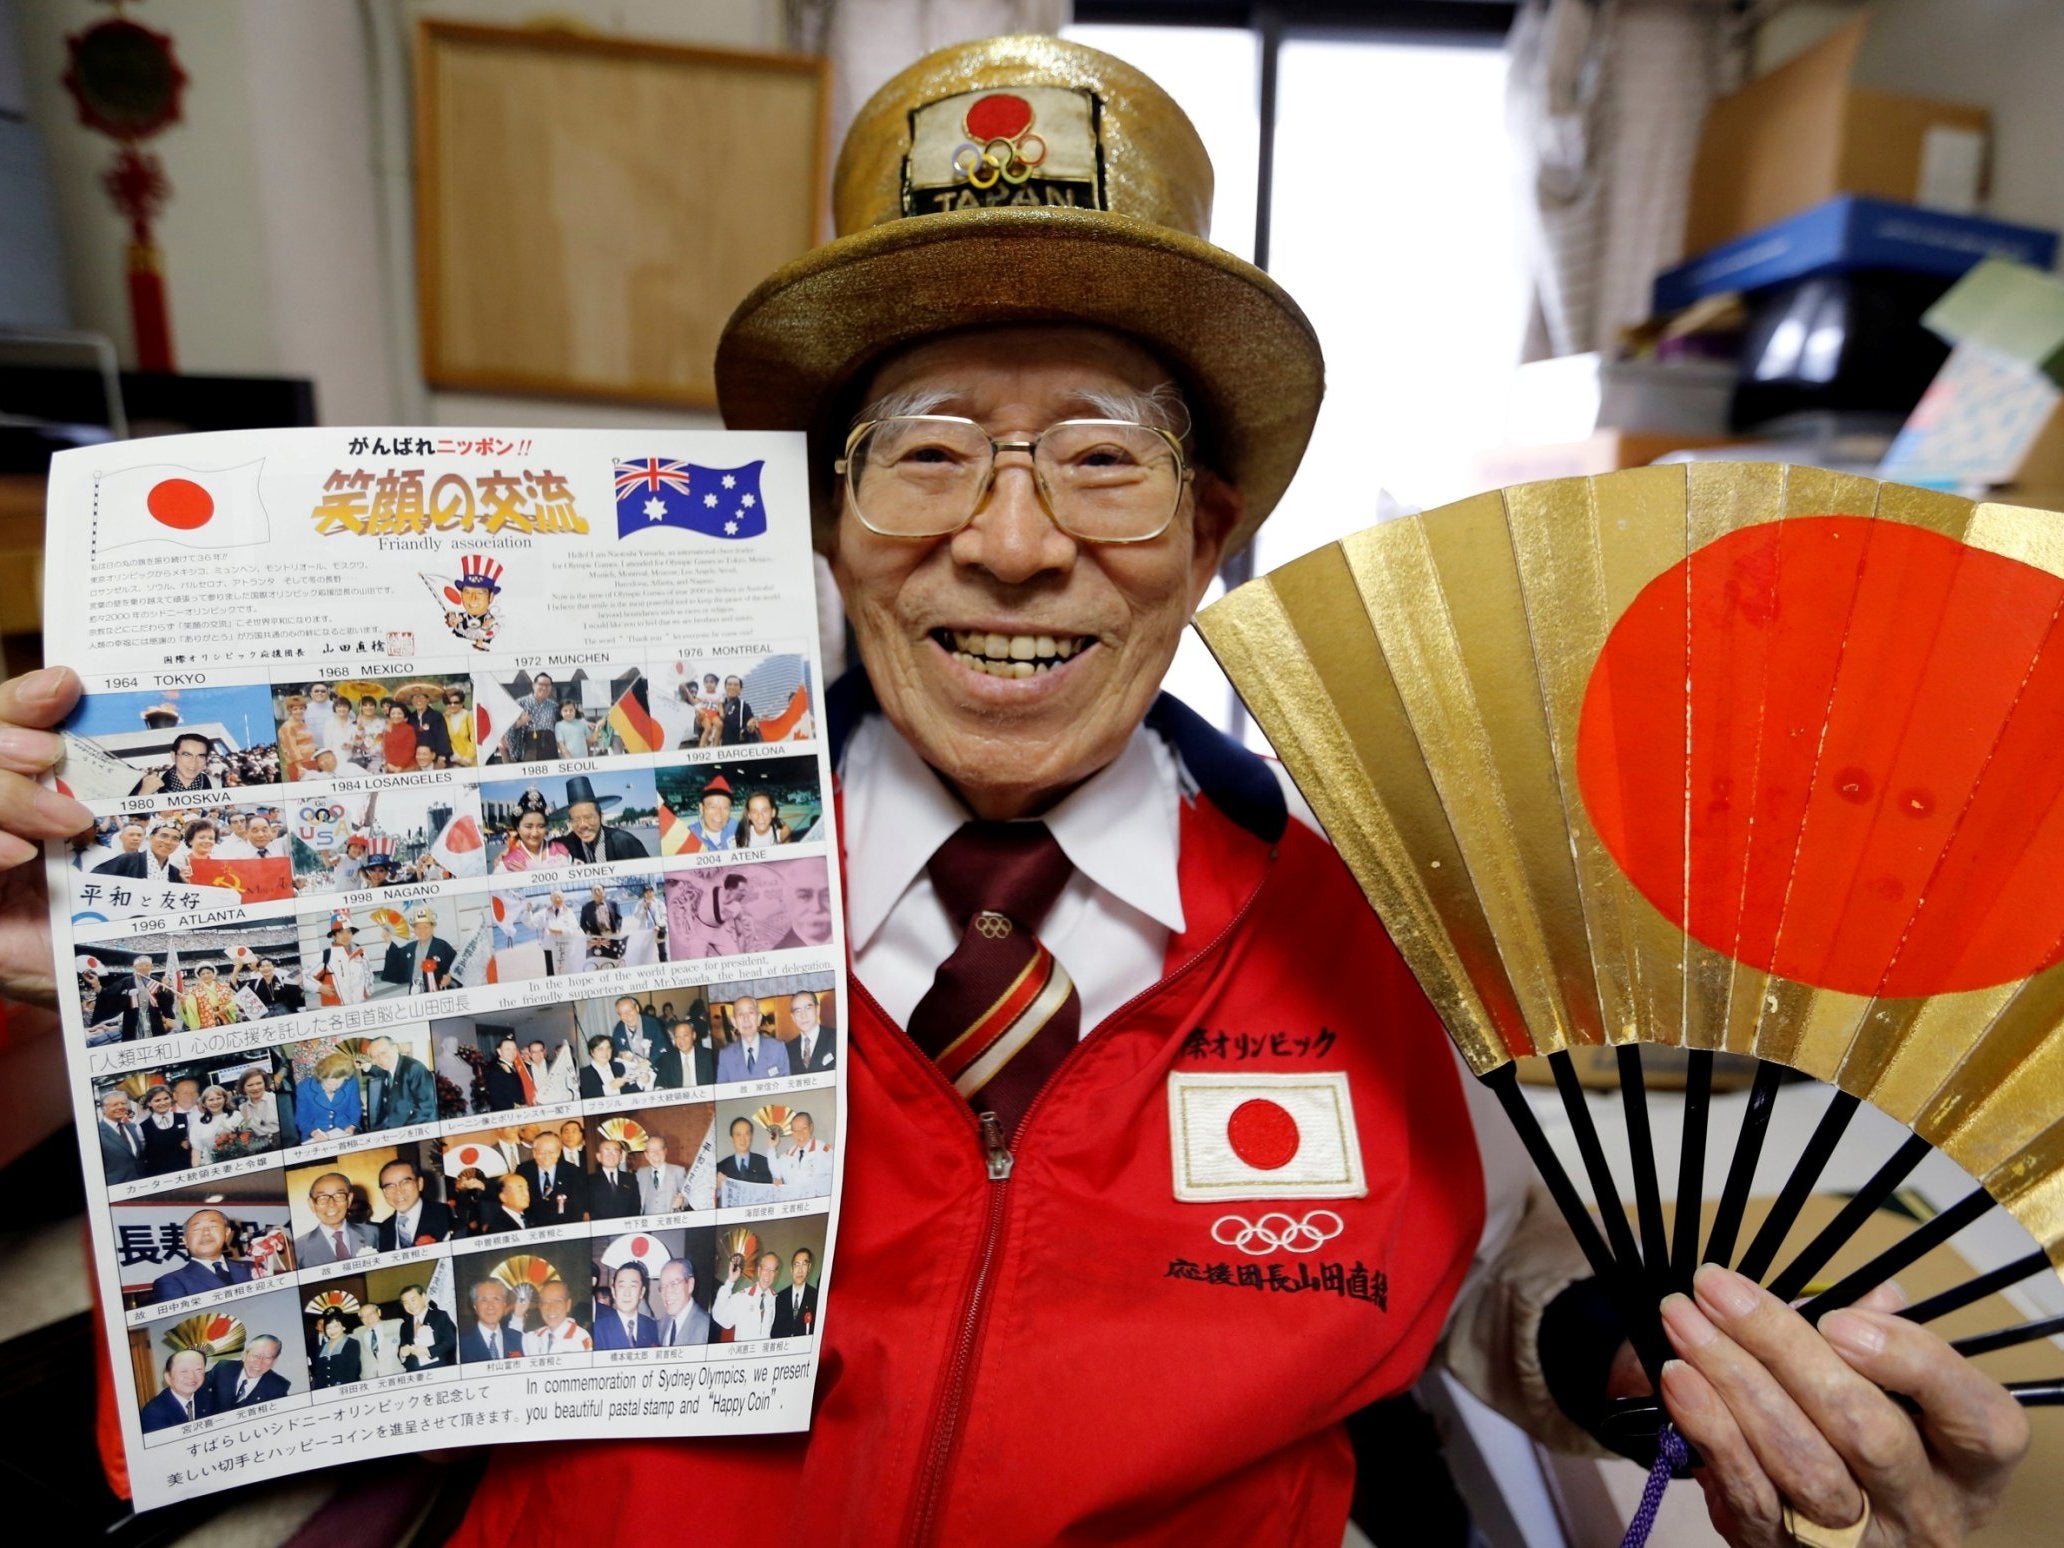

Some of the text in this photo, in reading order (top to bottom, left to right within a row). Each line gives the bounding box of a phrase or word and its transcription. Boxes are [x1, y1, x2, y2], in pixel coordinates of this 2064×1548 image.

[310, 468, 590, 536] 笑顔の交流
[514, 652, 610, 667] 1972 MUNCHEN
[678, 643, 774, 659] 1976 MONTREAL
[105, 673, 206, 690] 1964 TOKYO
[319, 663, 414, 679] 1968 MEXICO
[687, 744, 786, 763] 1992 BARCELONA
[522, 761, 599, 777] 1988 SEOUL
[331, 772, 452, 793] 1984 LOSANGELES
[120, 791, 232, 812] 1980 MOSKVA
[696, 850, 767, 866] 2004 ATENE
[531, 865, 616, 883] 2000 SYDNEY
[79, 883, 201, 911] 平和と友好
[343, 884, 440, 905] 1998 NAGANO
[131, 908, 247, 934] 1996 ATLANTA
[528, 981, 541, 993] In
[545, 978, 563, 991] the
[568, 975, 595, 990] hope
[600, 974, 610, 985] of
[615, 970, 632, 982] the
[636, 966, 666, 979] world
[671, 964, 700, 977] peace
[705, 960, 718, 971] for
[498, 997, 516, 1008] the
[521, 990, 563, 1007] friendly
[629, 980, 649, 992] and
[526, 1360, 811, 1395] In commemoration of Sydney Olympics, we present
[525, 1404, 548, 1425] you
[554, 1399, 603, 1420] beautiful
[609, 1397, 640, 1421] pastal
[643, 1397, 674, 1419] stamp
[680, 1395, 699, 1415] and
[186, 1385, 490, 1458] すばらしいシドニーオリンピックを記念して
[166, 1407, 521, 1488] 美しい切手とハッピーコインを進呈させて頂きます。
